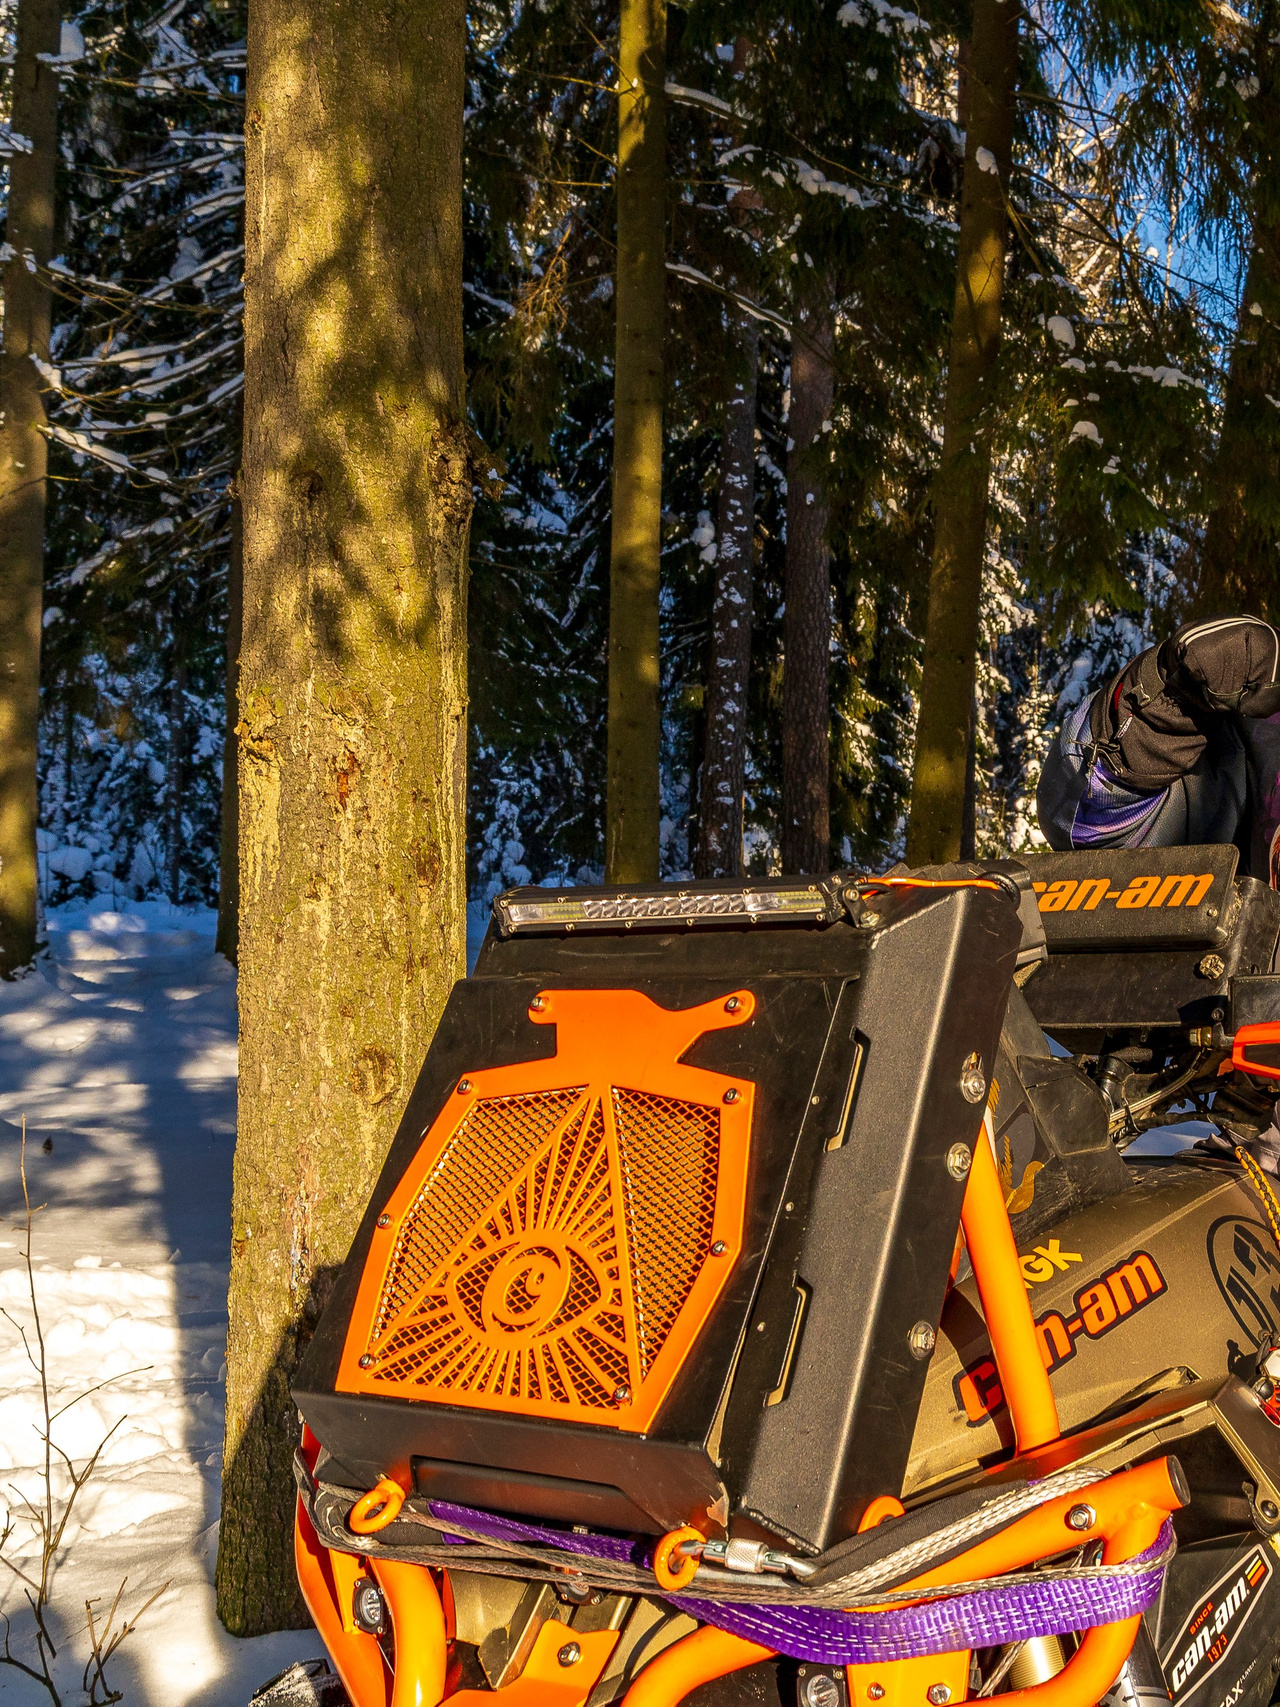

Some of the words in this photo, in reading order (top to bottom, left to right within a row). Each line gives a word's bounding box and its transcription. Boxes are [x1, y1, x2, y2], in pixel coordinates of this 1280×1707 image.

[1018, 1238, 1083, 1290] GK
[957, 1253, 1164, 1423] cn-am
[1171, 1576, 1248, 1693] can-am
[1189, 1601, 1214, 1636] SINCE
[1206, 1633, 1229, 1664] 1973
